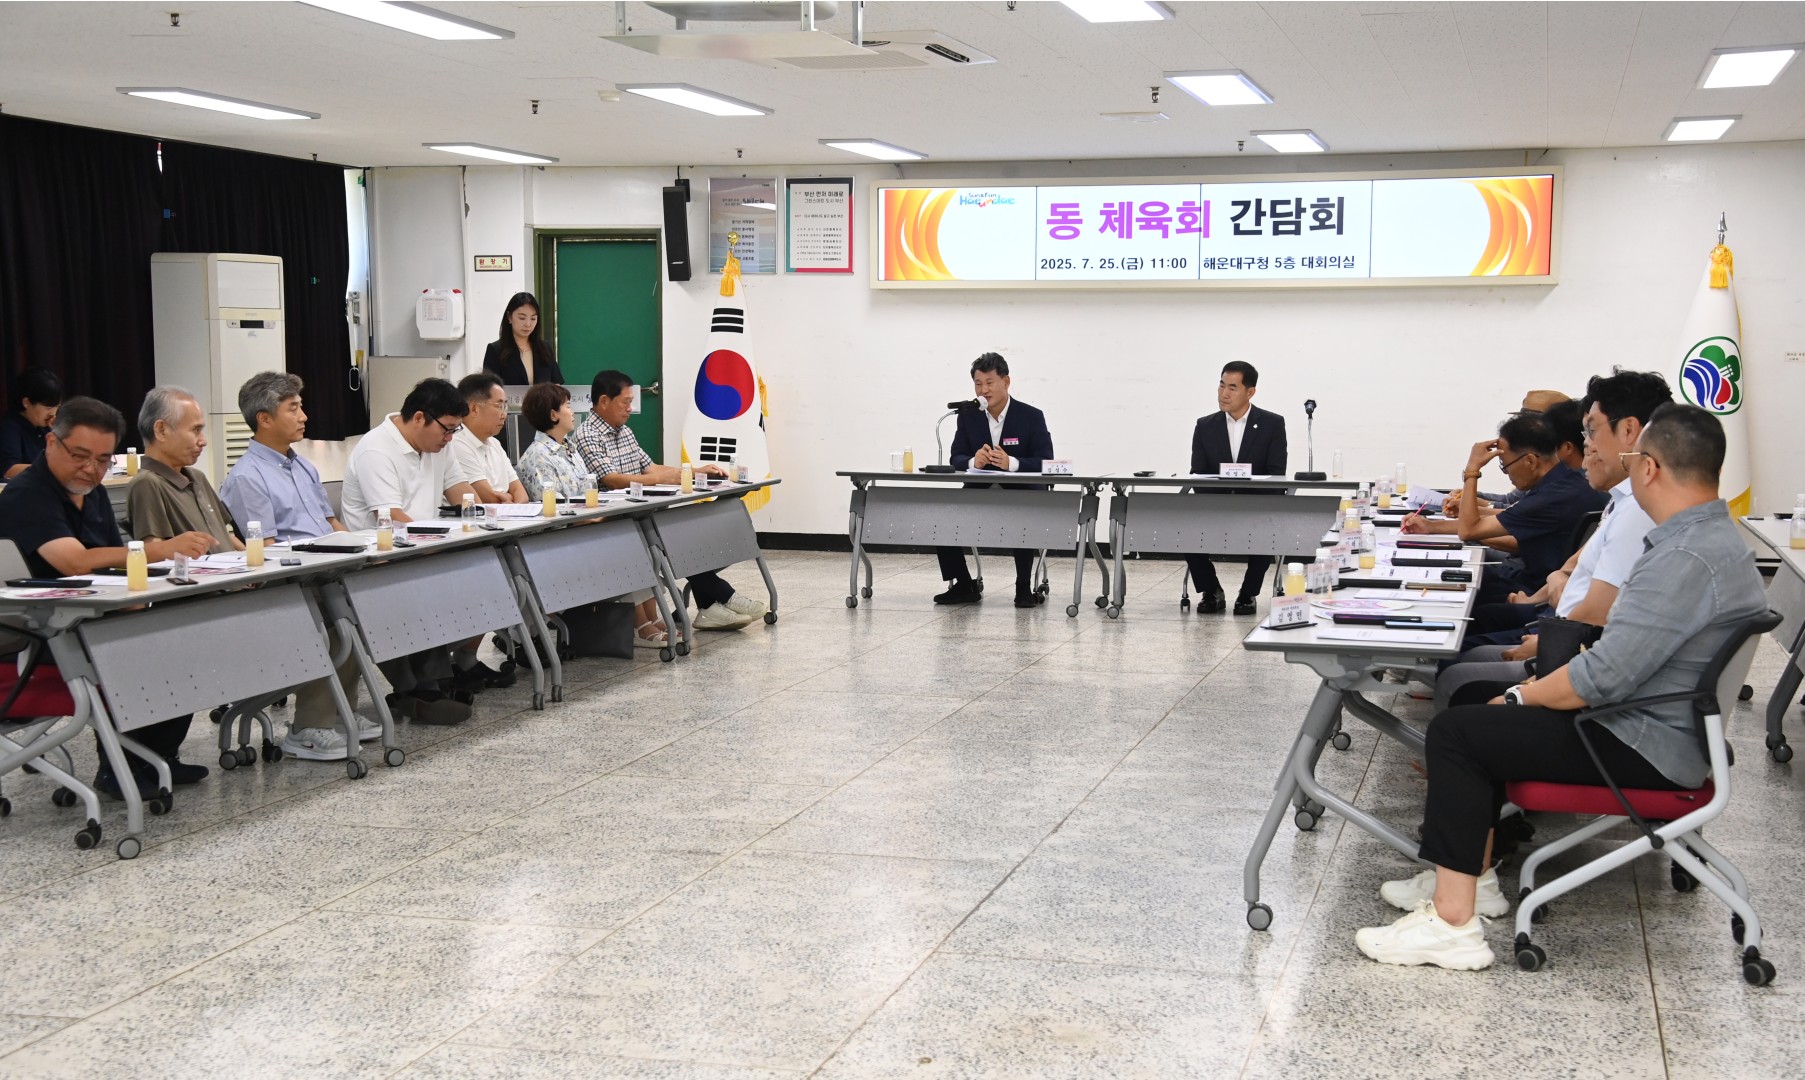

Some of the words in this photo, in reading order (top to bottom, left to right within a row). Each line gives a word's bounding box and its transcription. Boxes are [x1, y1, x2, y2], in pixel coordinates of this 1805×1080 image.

[1046, 202, 1083, 240] 동
[1098, 200, 1211, 239] 체육회
[1230, 197, 1345, 236] 간담회
[1040, 258, 1077, 270] 2025.
[1081, 258, 1094, 270] 7.
[1099, 257, 1144, 271] 25.(금)
[1150, 257, 1188, 269] 11:00
[1203, 256, 1269, 270] 해운대구청
[1274, 256, 1297, 270] 5층
[1301, 255, 1355, 270] 대회의실
